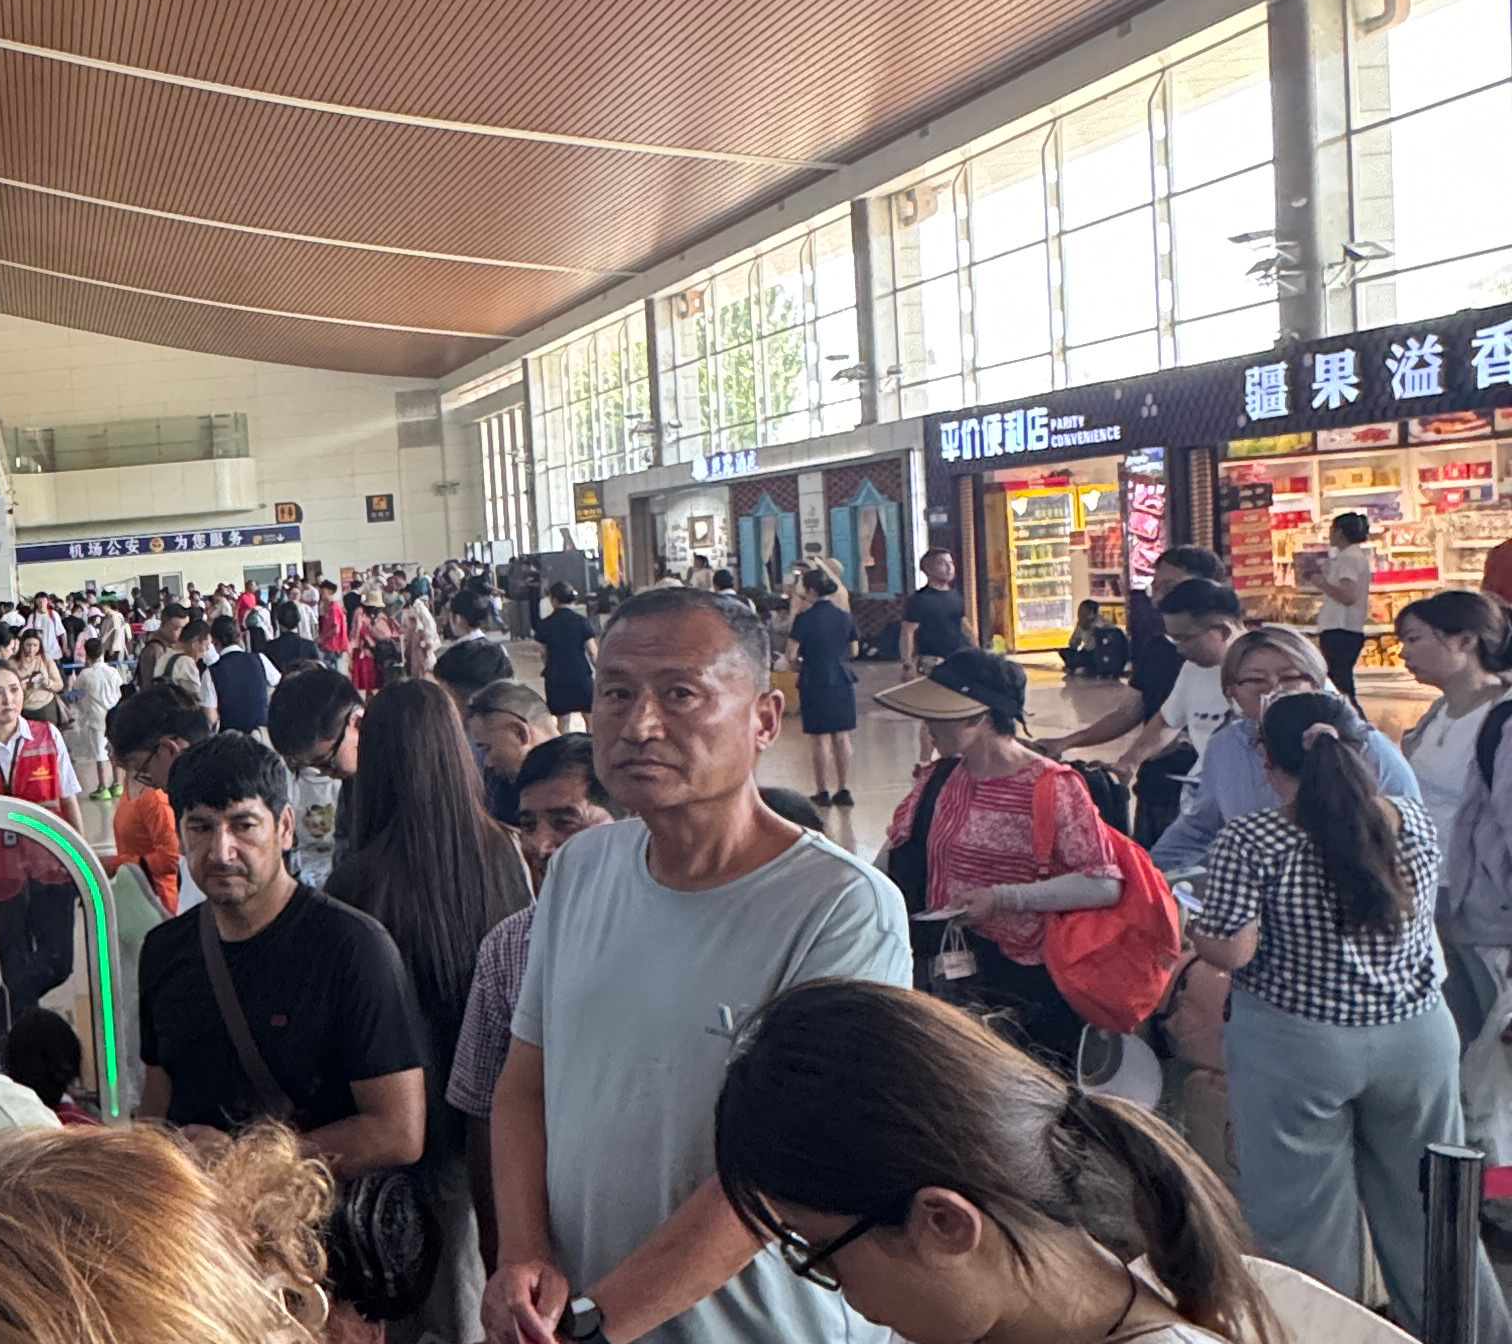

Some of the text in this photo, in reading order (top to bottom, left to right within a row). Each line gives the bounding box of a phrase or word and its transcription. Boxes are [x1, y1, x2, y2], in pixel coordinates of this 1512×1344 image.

[1245, 319, 1512, 422] 疆果溢香
[940, 406, 1049, 462] 平价便利店
[1050, 414, 1085, 432] PARITY
[1050, 425, 1122, 449] CONVENIENCE
[69, 530, 244, 559] 机场公安 为您服务
